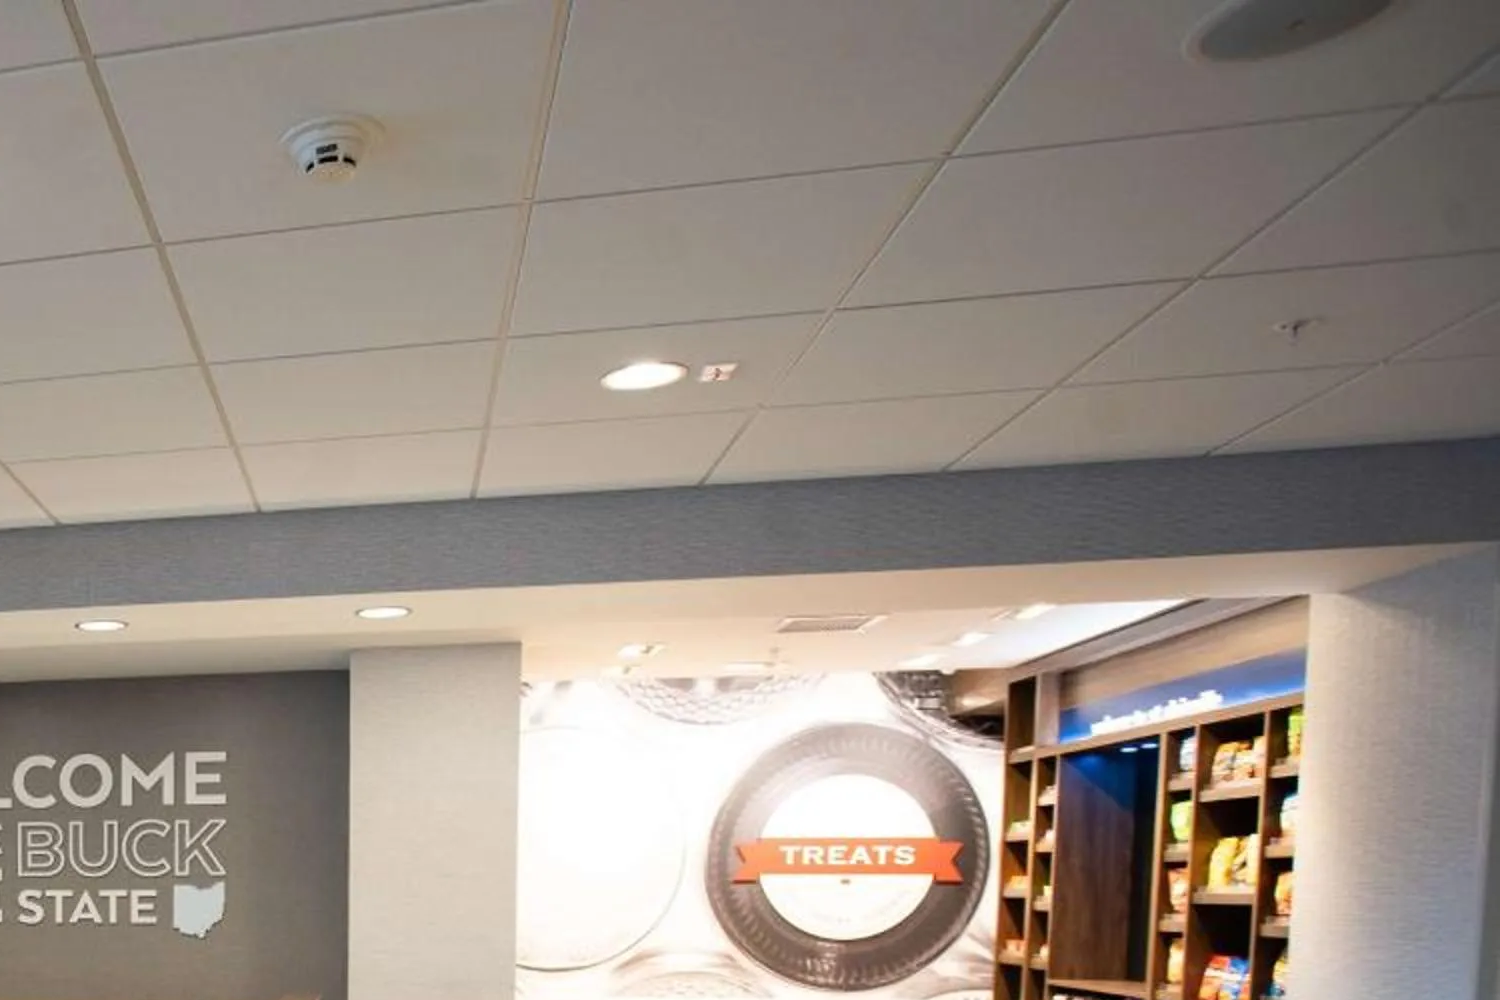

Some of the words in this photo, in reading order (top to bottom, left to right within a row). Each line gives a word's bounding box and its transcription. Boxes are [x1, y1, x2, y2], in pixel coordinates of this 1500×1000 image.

[16, 818, 227, 877] BUCK
[778, 844, 916, 866] TREATS
[16, 888, 158, 925] STATE
